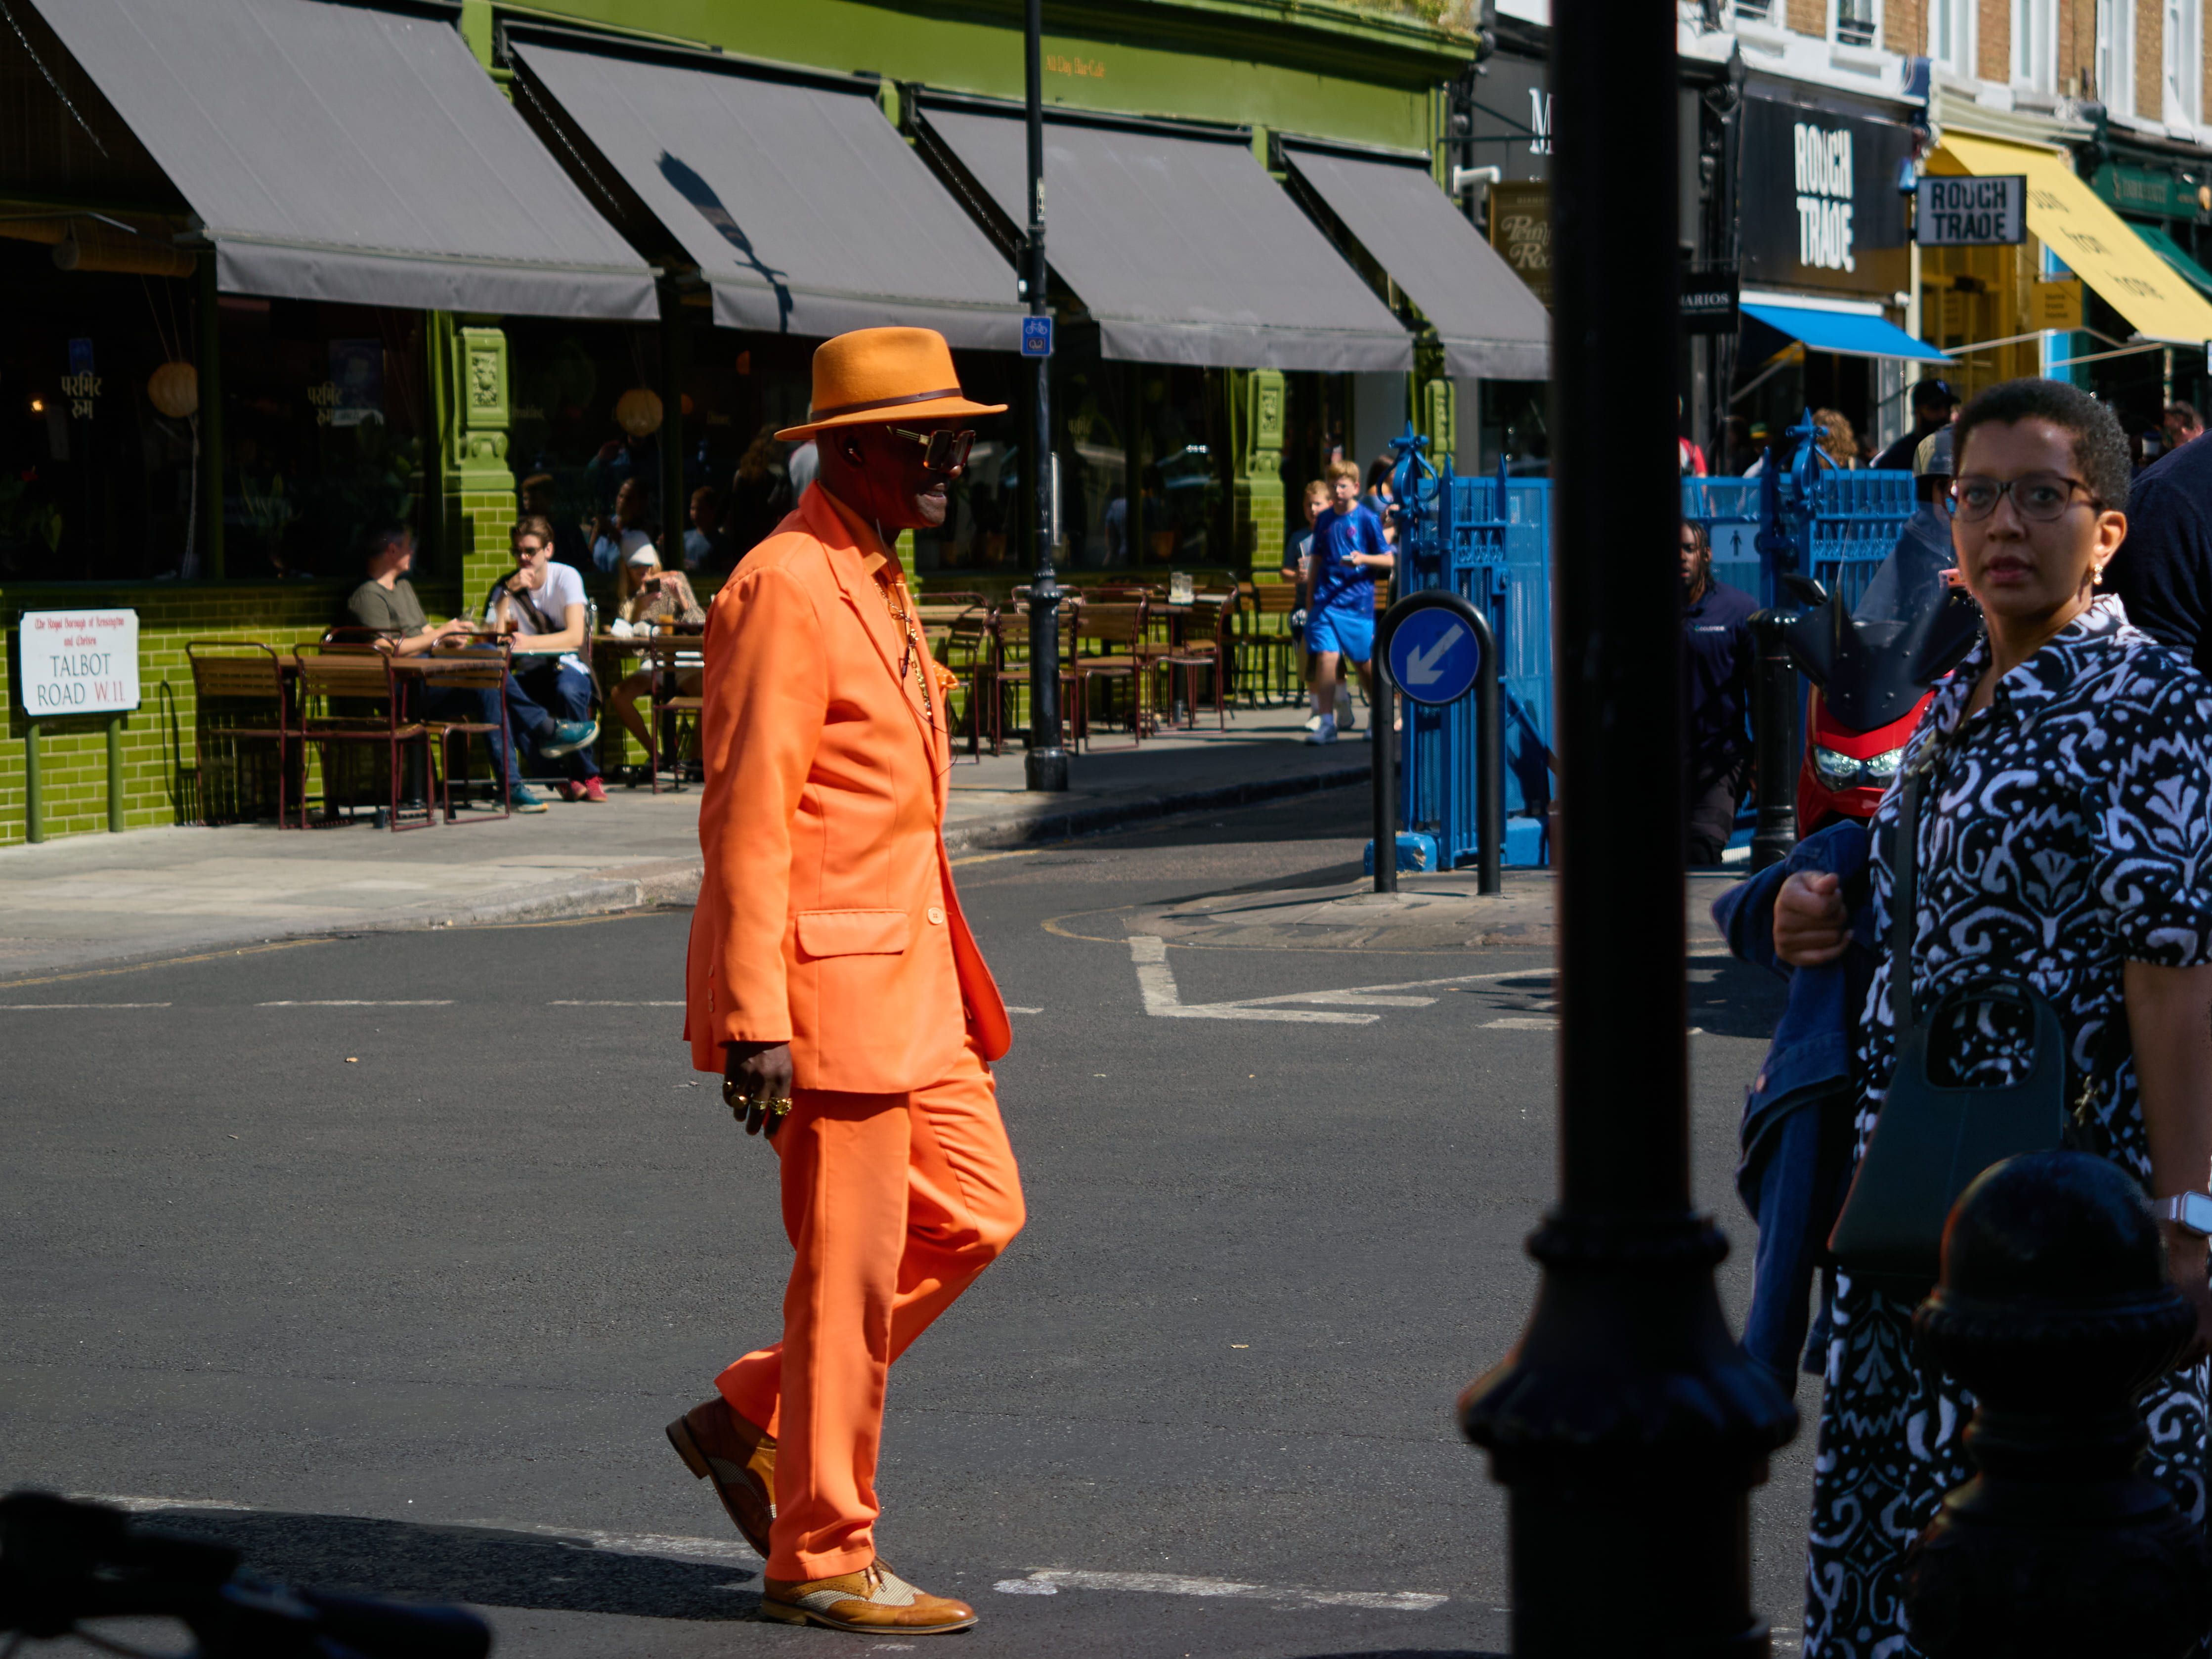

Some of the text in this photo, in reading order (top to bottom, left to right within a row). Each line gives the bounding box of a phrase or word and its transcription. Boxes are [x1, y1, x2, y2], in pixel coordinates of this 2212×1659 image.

[1528, 87, 1553, 155] M
[1794, 123, 1853, 199] ROUGH
[1931, 181, 2006, 210] ROUGH
[1796, 195, 1856, 272] TRADE
[1931, 213, 2007, 240] TRADE
[35, 615, 125, 633] The Royal Borough of Kensington
[64, 634, 96, 647] and Chelsea
[50, 653, 111, 677] TALBOT
[37, 682, 86, 706] ROAD
